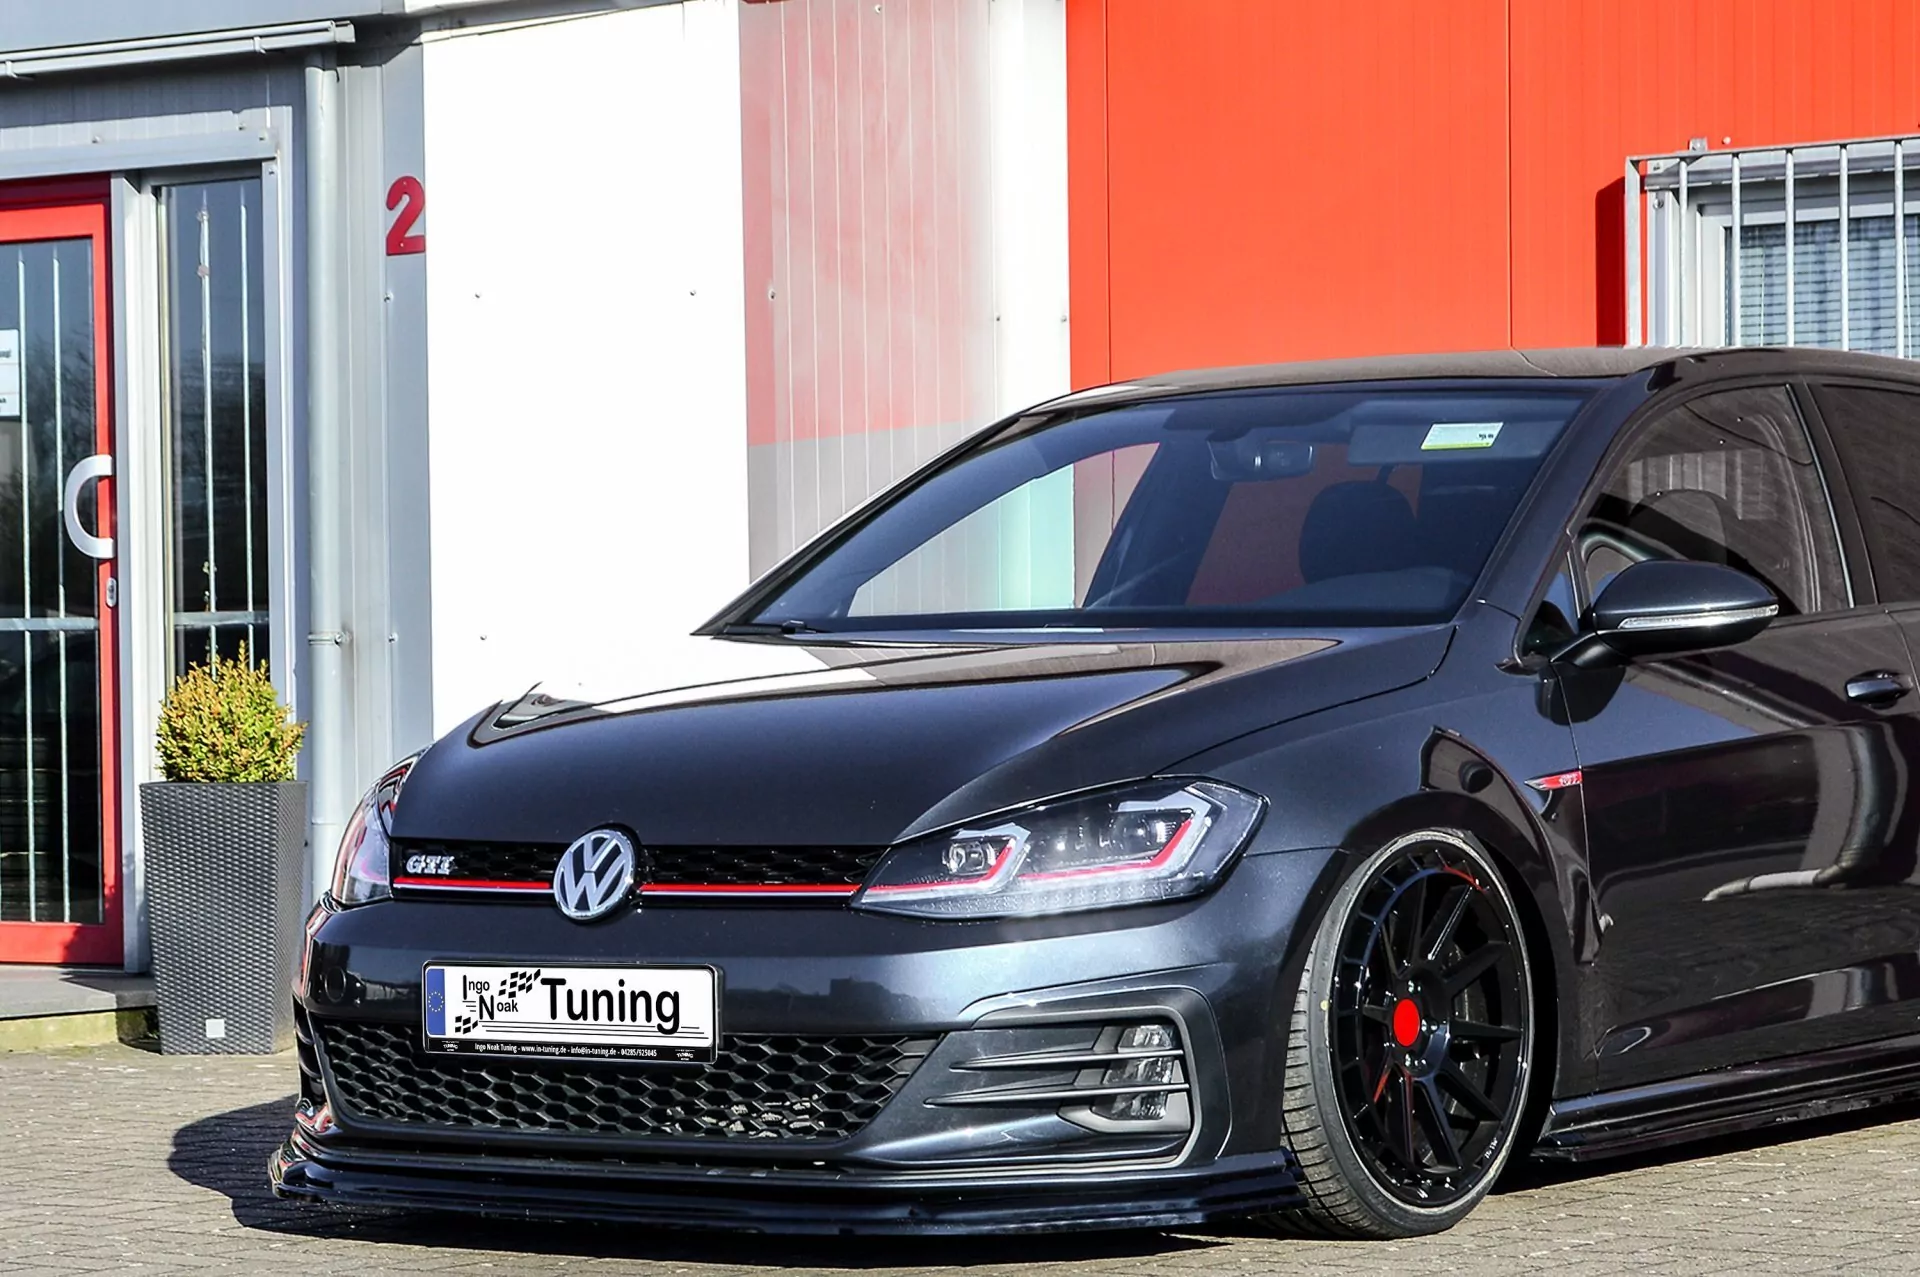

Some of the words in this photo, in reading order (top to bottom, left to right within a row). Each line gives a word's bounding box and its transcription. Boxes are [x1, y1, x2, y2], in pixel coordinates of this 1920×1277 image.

[386, 175, 425, 256] 2
[406, 855, 455, 875] GTI
[554, 829, 635, 920] VW
[462, 974, 490, 1001] Ingo
[479, 994, 519, 1021] Noak
[540, 977, 680, 1035] Tuning
[474, 1042, 486, 1052] Ingo
[487, 1042, 500, 1051] Noak
[501, 1043, 517, 1054] Tuning
[521, 1044, 566, 1055] www.in-tuning.de
